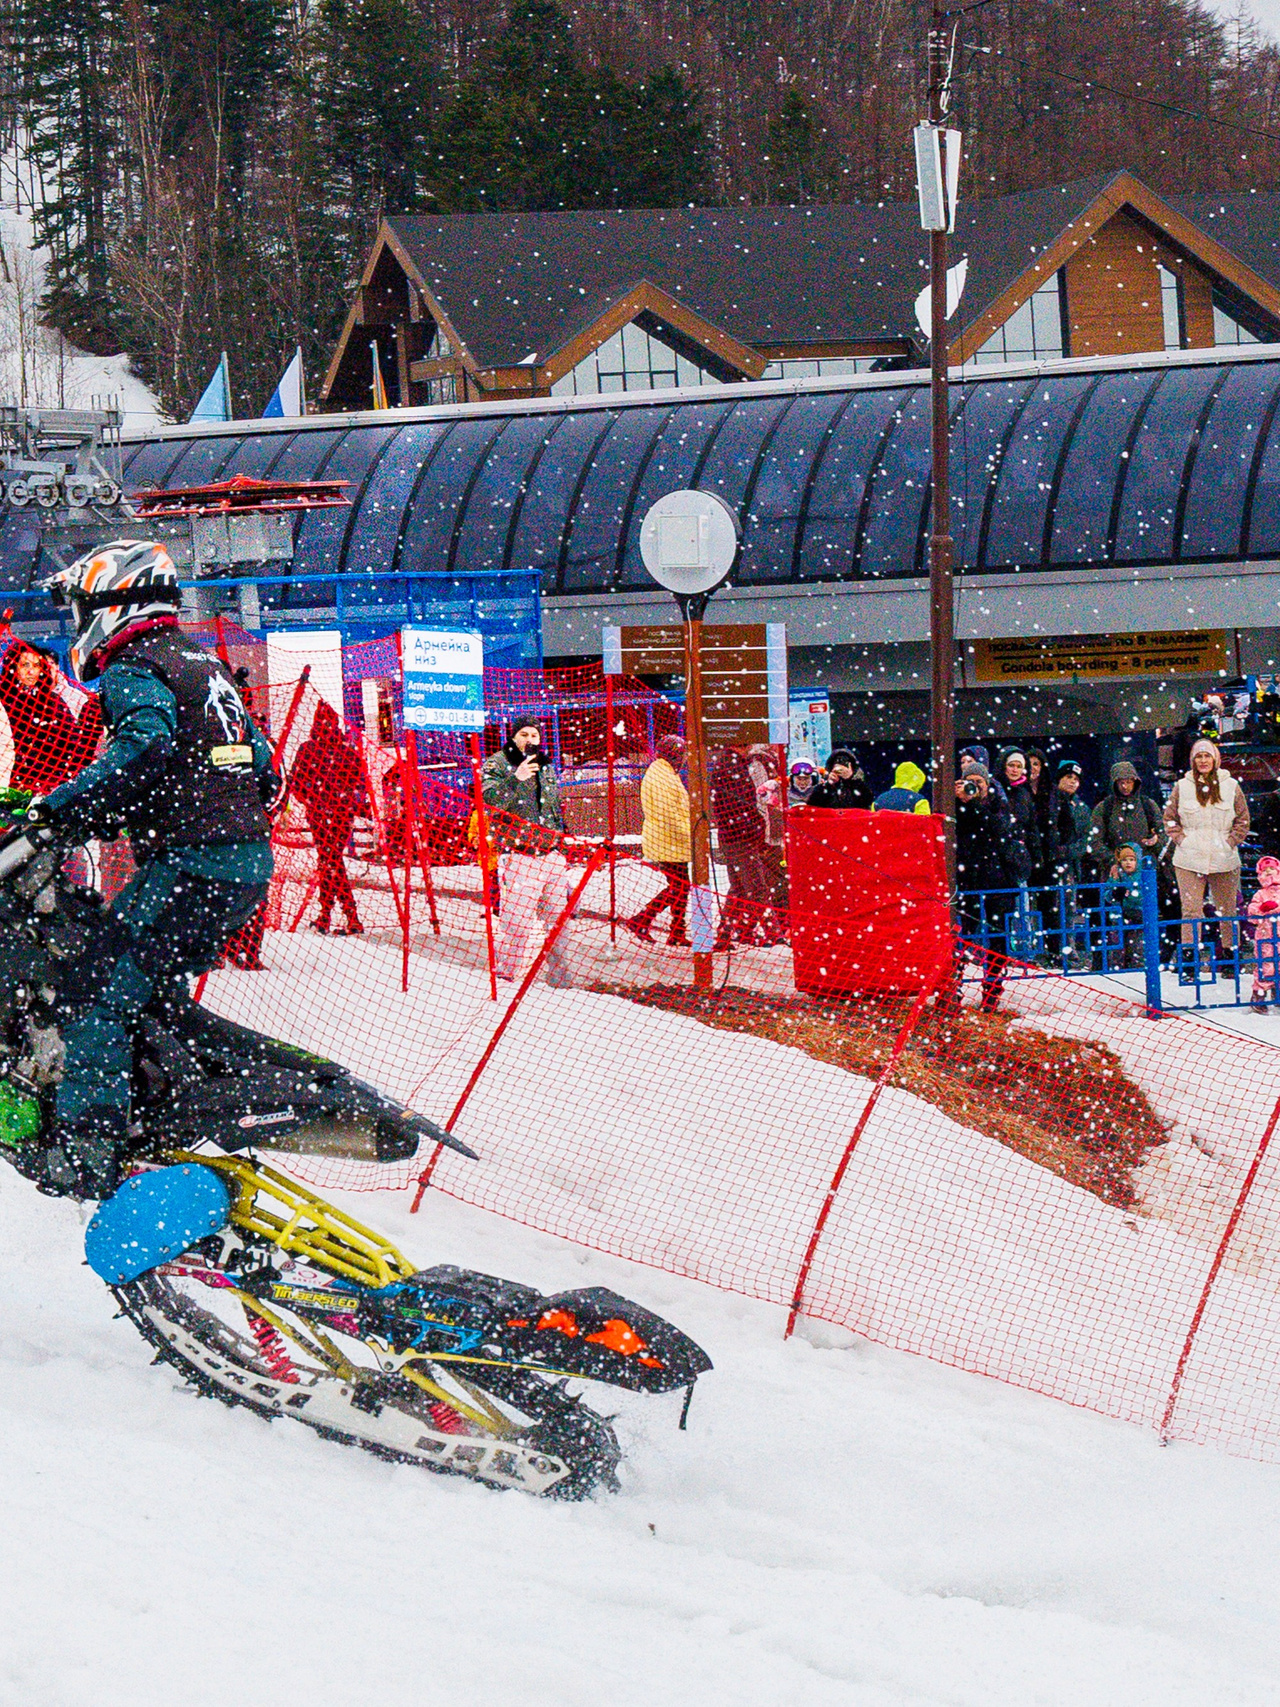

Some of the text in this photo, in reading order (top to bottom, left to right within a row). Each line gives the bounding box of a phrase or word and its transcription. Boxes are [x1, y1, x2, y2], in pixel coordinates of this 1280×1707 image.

[414, 637, 470, 655] Армейка
[414, 655, 437, 665] низ
[1001, 660, 1054, 673] Gondola
[1057, 657, 1119, 672] boarding
[1132, 657, 1141, 668] 8
[1144, 655, 1201, 669] persons
[408, 680, 467, 694] Armeyka down
[433, 711, 475, 723] 39-01-84
